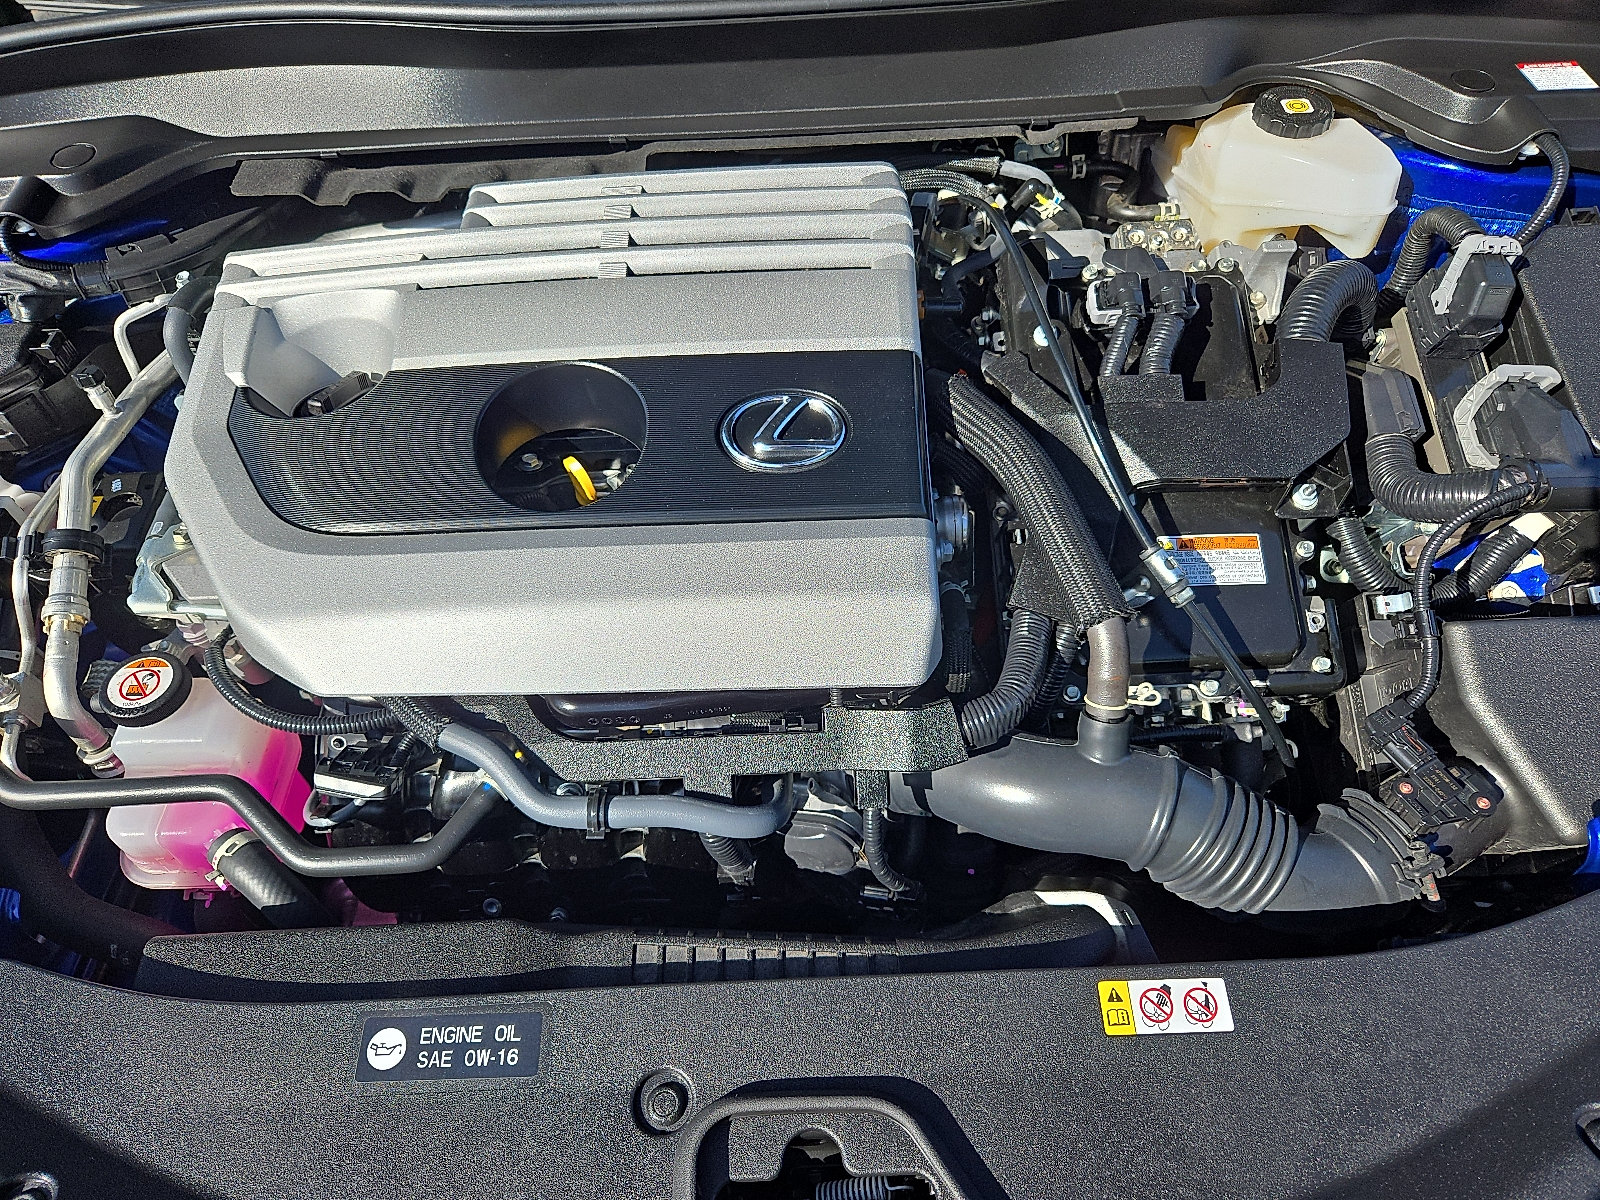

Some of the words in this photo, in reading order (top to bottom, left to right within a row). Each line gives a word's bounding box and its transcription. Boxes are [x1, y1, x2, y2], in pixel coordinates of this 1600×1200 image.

[419, 1025, 484, 1045] ENGINE
[494, 1024, 521, 1042] OIL
[416, 1050, 454, 1069] SAE
[464, 1048, 519, 1067] 0W-16
